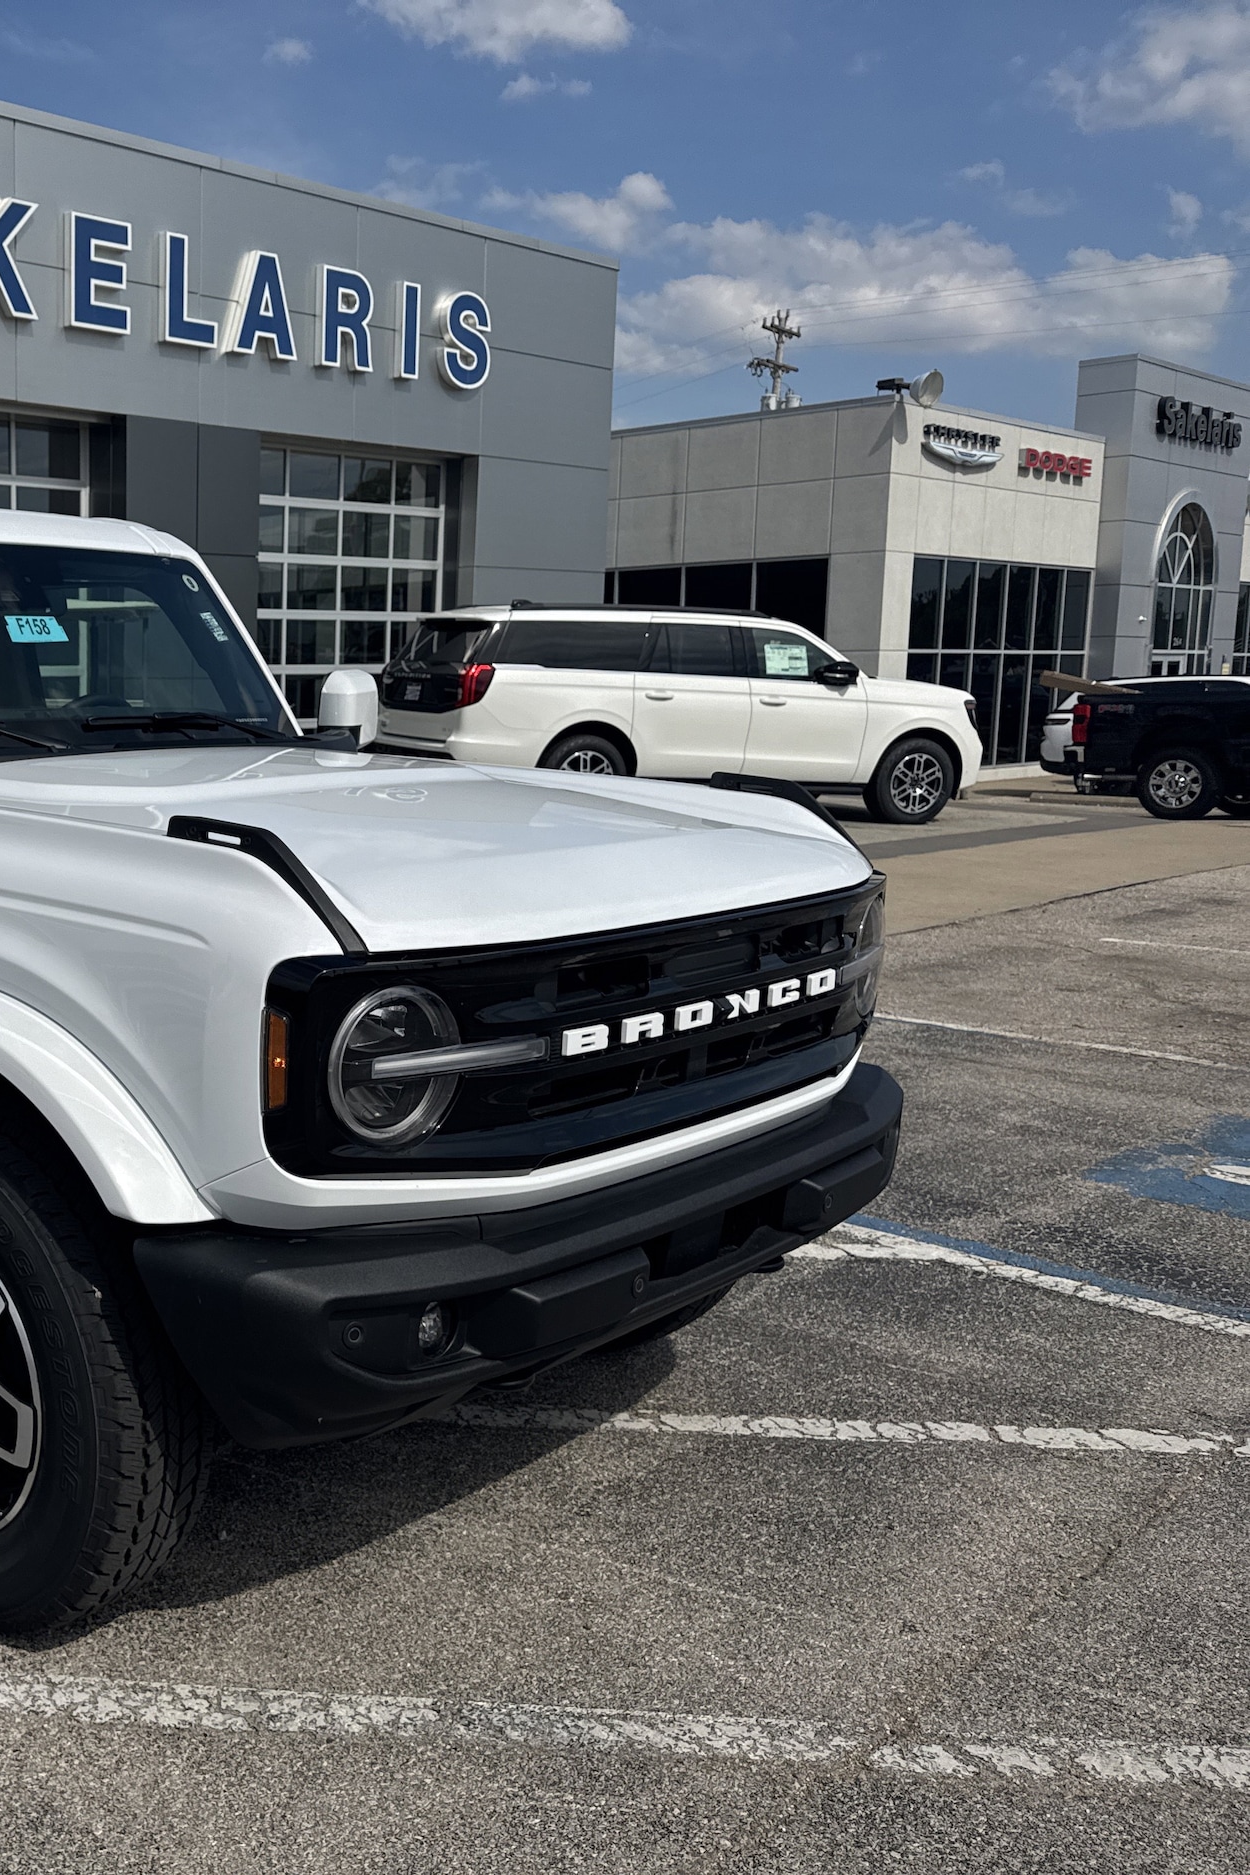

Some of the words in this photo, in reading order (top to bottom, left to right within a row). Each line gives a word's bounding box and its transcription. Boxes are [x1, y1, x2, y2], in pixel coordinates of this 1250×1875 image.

[1158, 396, 1242, 449] Sakelaris
[1024, 447, 1092, 477] DODGE
[15, 617, 51, 635] F158
[561, 967, 837, 1057] BRONCO
